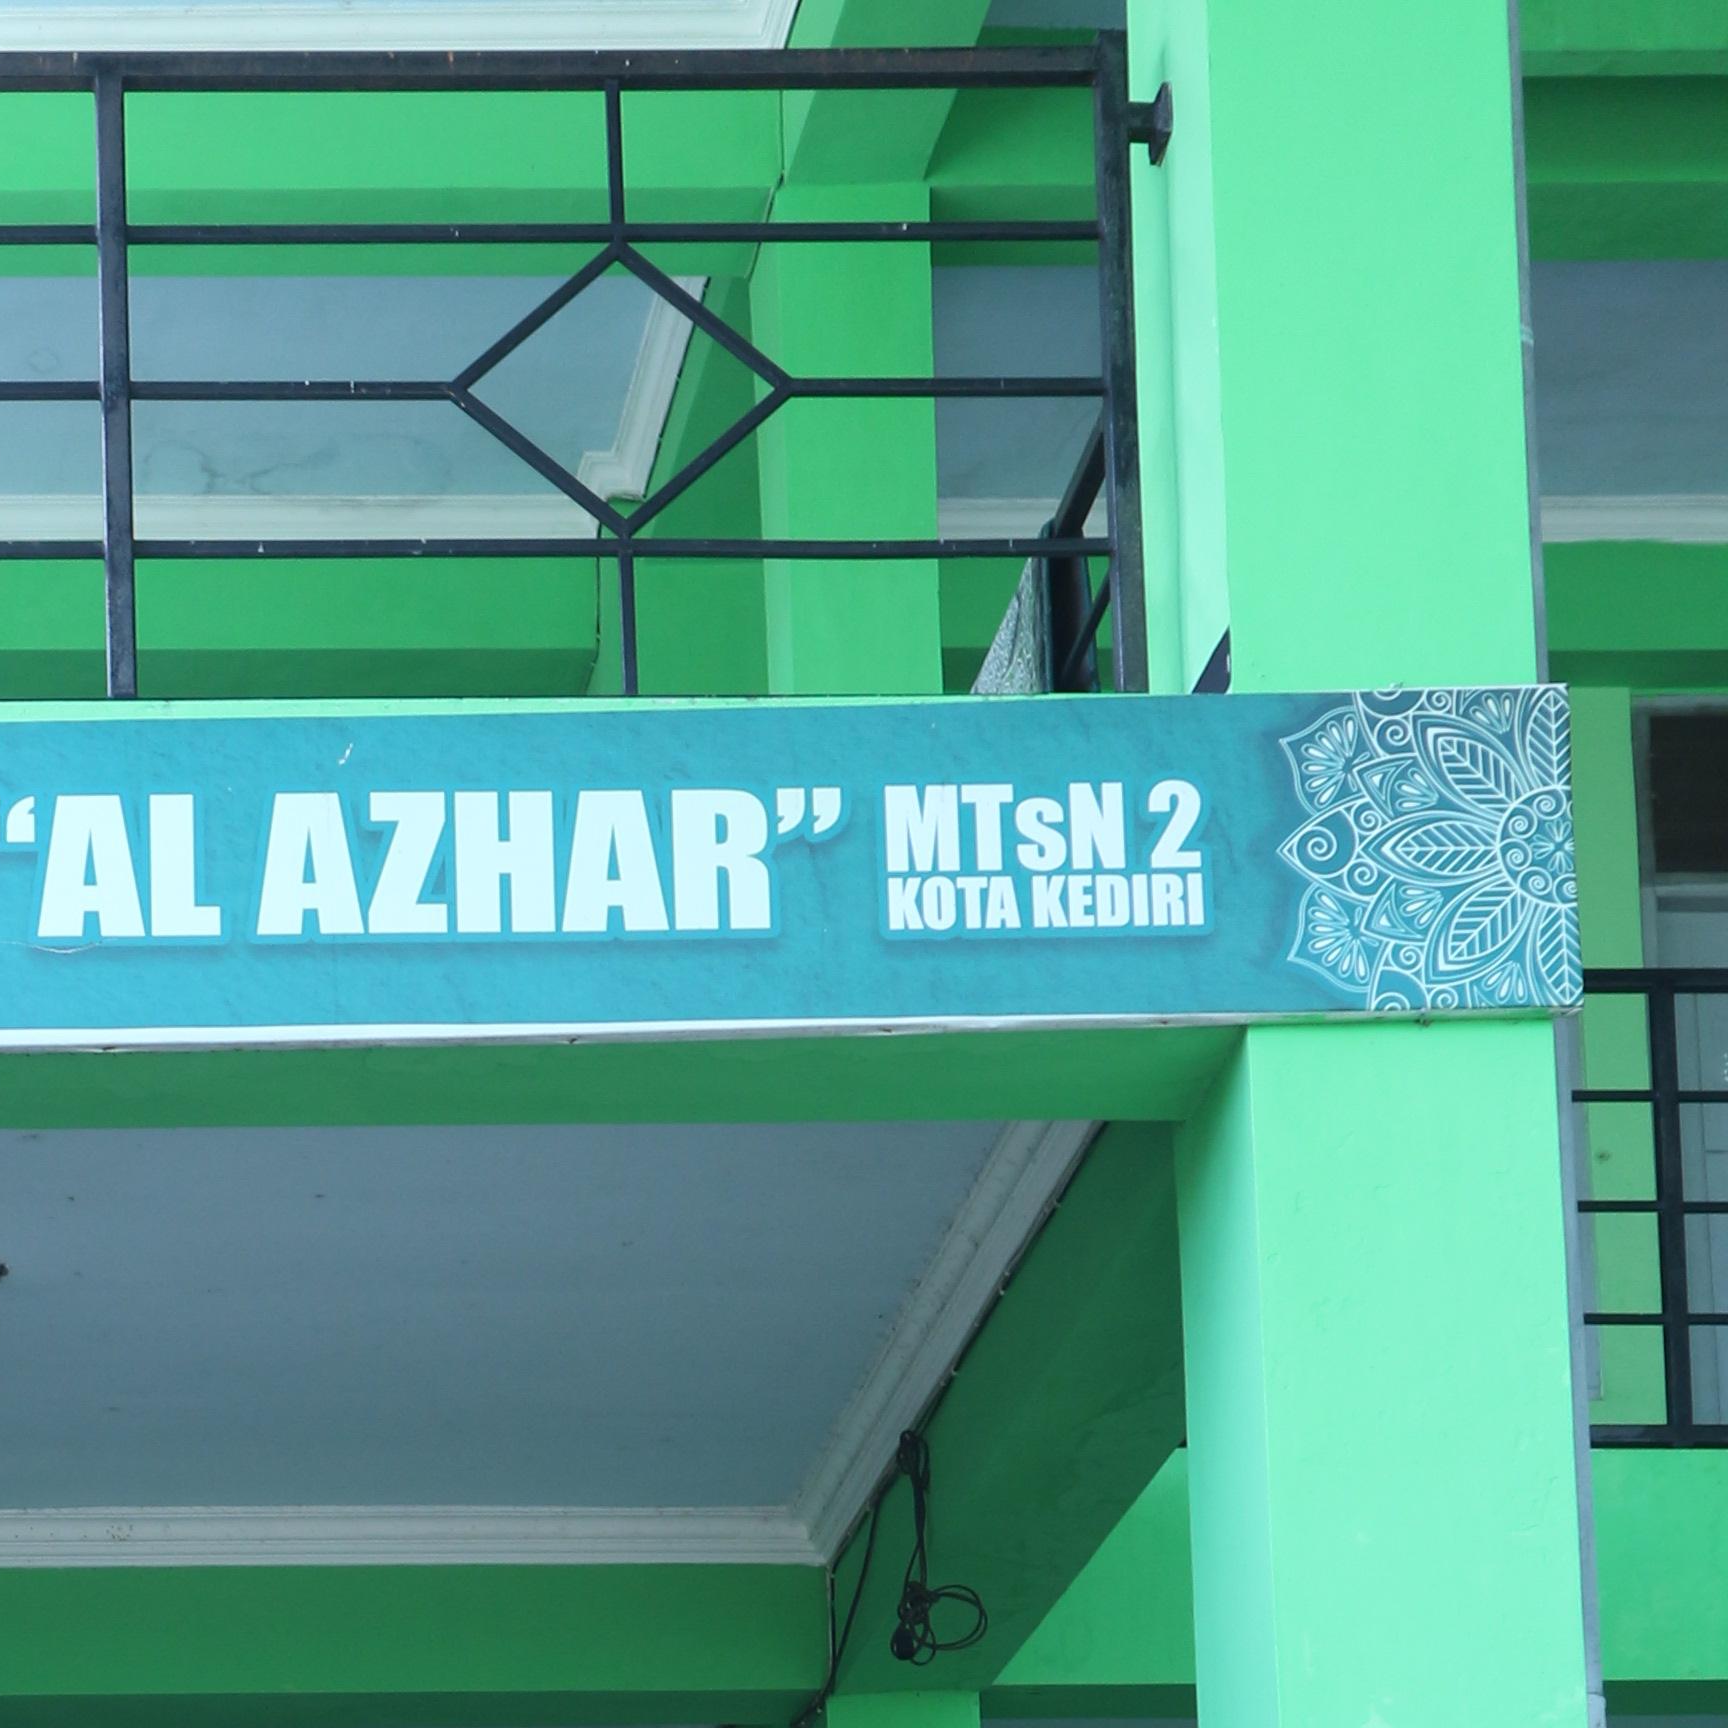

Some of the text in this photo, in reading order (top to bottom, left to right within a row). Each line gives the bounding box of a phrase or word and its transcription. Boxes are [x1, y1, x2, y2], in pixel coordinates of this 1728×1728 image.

[884, 779, 1202, 872] MTsN 2
[887, 872, 1205, 930] KOTA KEDIRI
